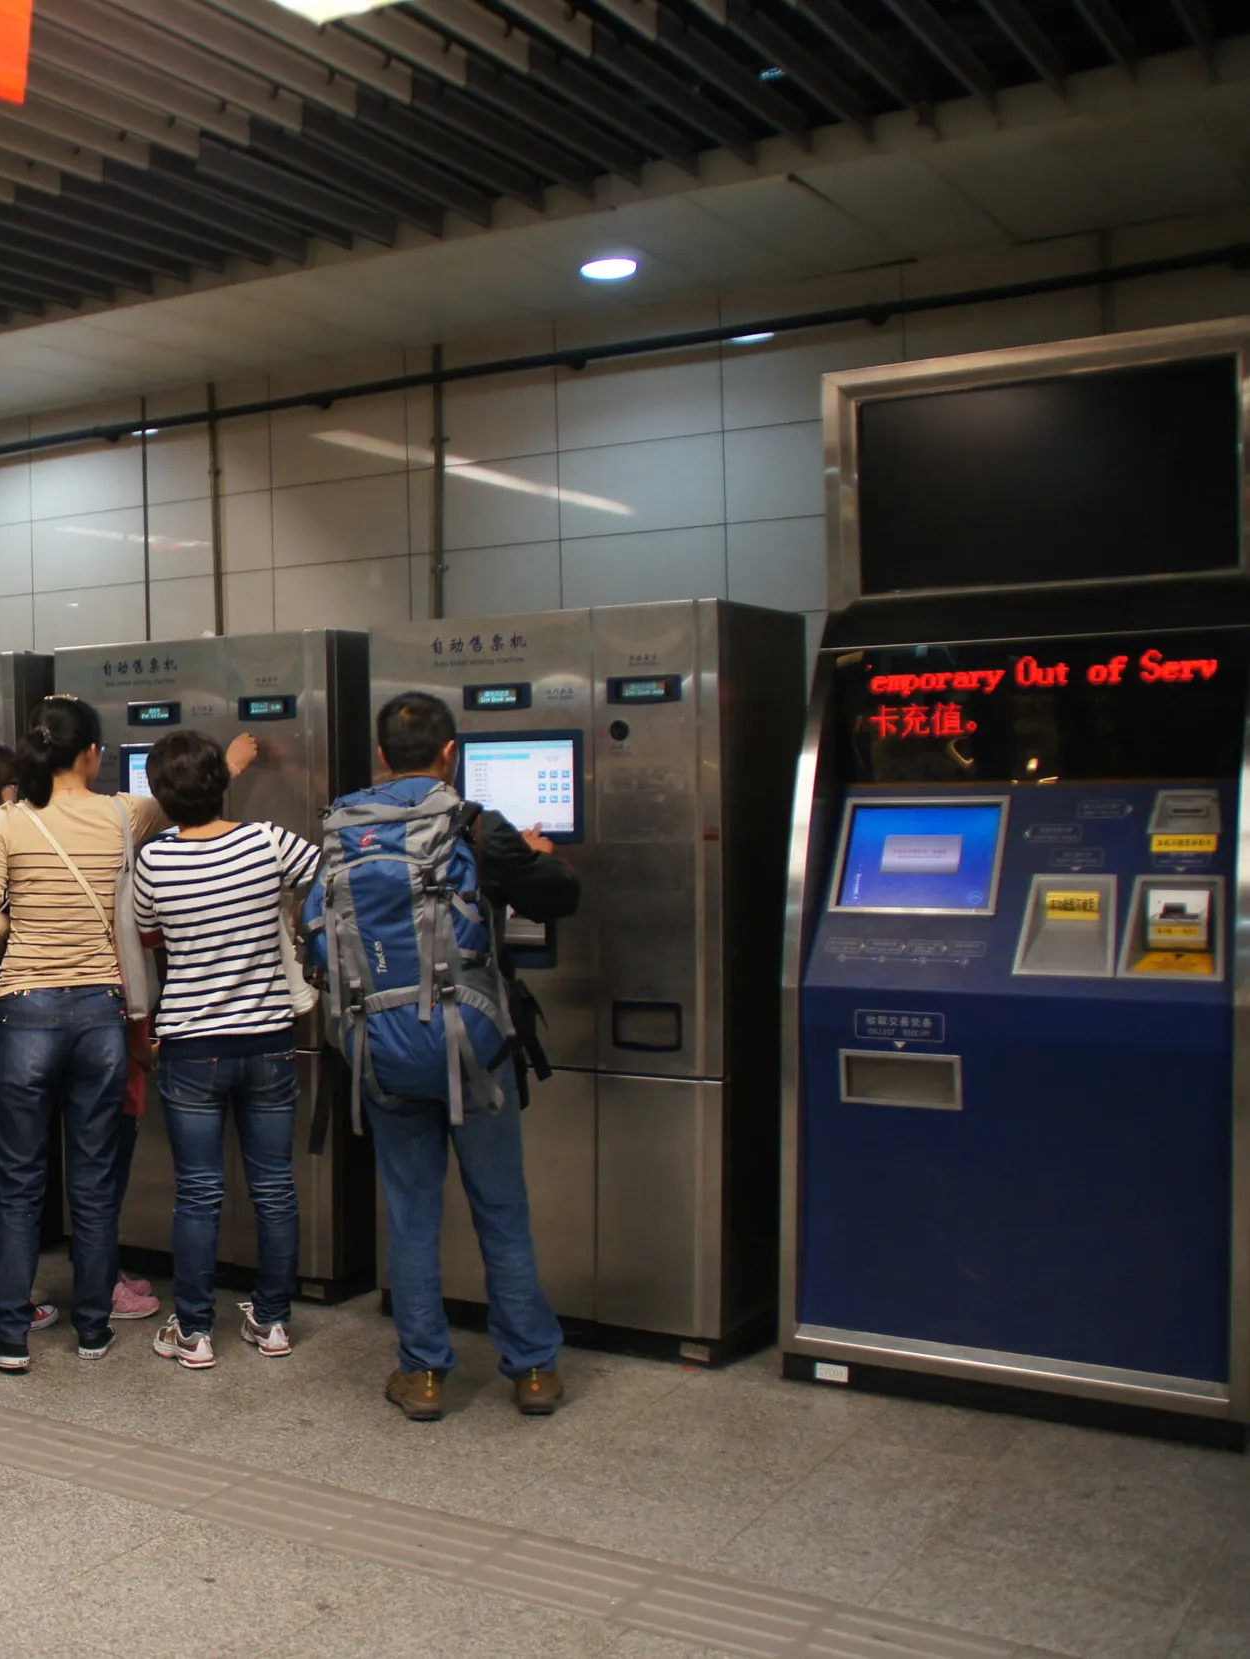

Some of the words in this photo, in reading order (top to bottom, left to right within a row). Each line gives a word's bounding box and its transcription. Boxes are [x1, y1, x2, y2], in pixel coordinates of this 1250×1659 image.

[431, 631, 528, 655] 自动售票机
[103, 655, 178, 676] 自动售票机
[868, 669, 1006, 695] emporary
[1015, 656, 1070, 686] Out
[1087, 656, 1128, 685] of
[1139, 650, 1218, 683] Serv
